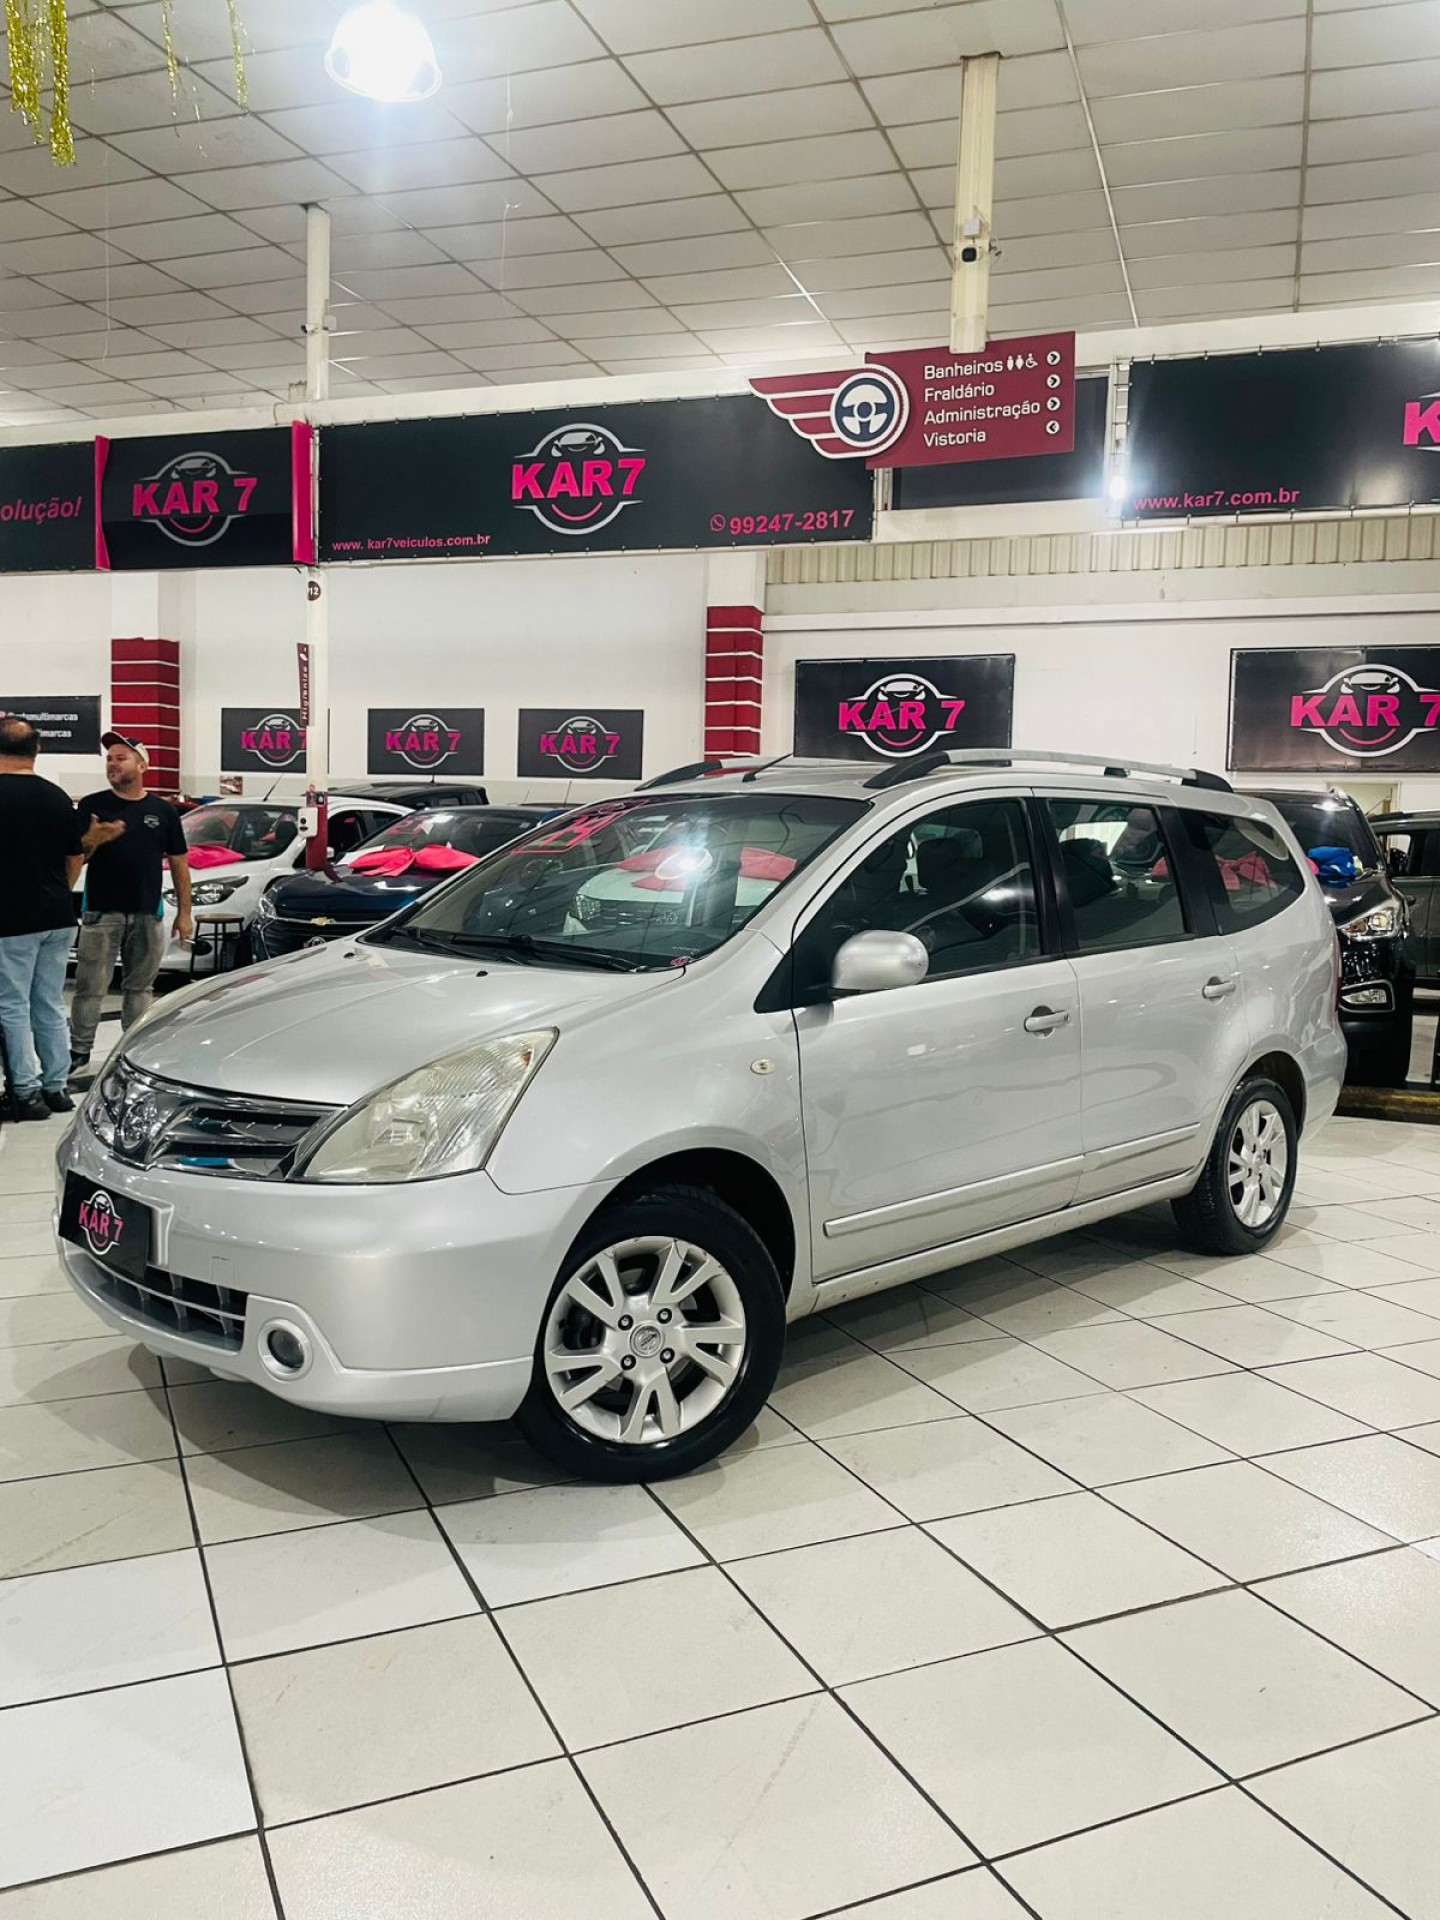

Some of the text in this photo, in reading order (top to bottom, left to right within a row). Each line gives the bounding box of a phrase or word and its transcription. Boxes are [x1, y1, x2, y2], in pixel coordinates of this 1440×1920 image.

[924, 360, 1003, 380] Banheiros
[924, 382, 995, 403] Fraldário
[923, 400, 1041, 425] Administração
[923, 428, 987, 447] Vistoria
[511, 457, 647, 500] KAR 7
[132, 477, 259, 517] KAR 7
[1133, 487, 1300, 510] www.kar7.com.br
[729, 509, 855, 536] 99247-2817
[367, 533, 492, 550] kar7veiculos.com.br
[838, 699, 966, 731] KAR 7
[1290, 694, 1440, 728] KAR 7
[241, 731, 291, 750] KAR
[385, 730, 462, 752] KAR 7
[539, 733, 620, 756] KAR 7
[78, 1202, 124, 1241] KAR 7
